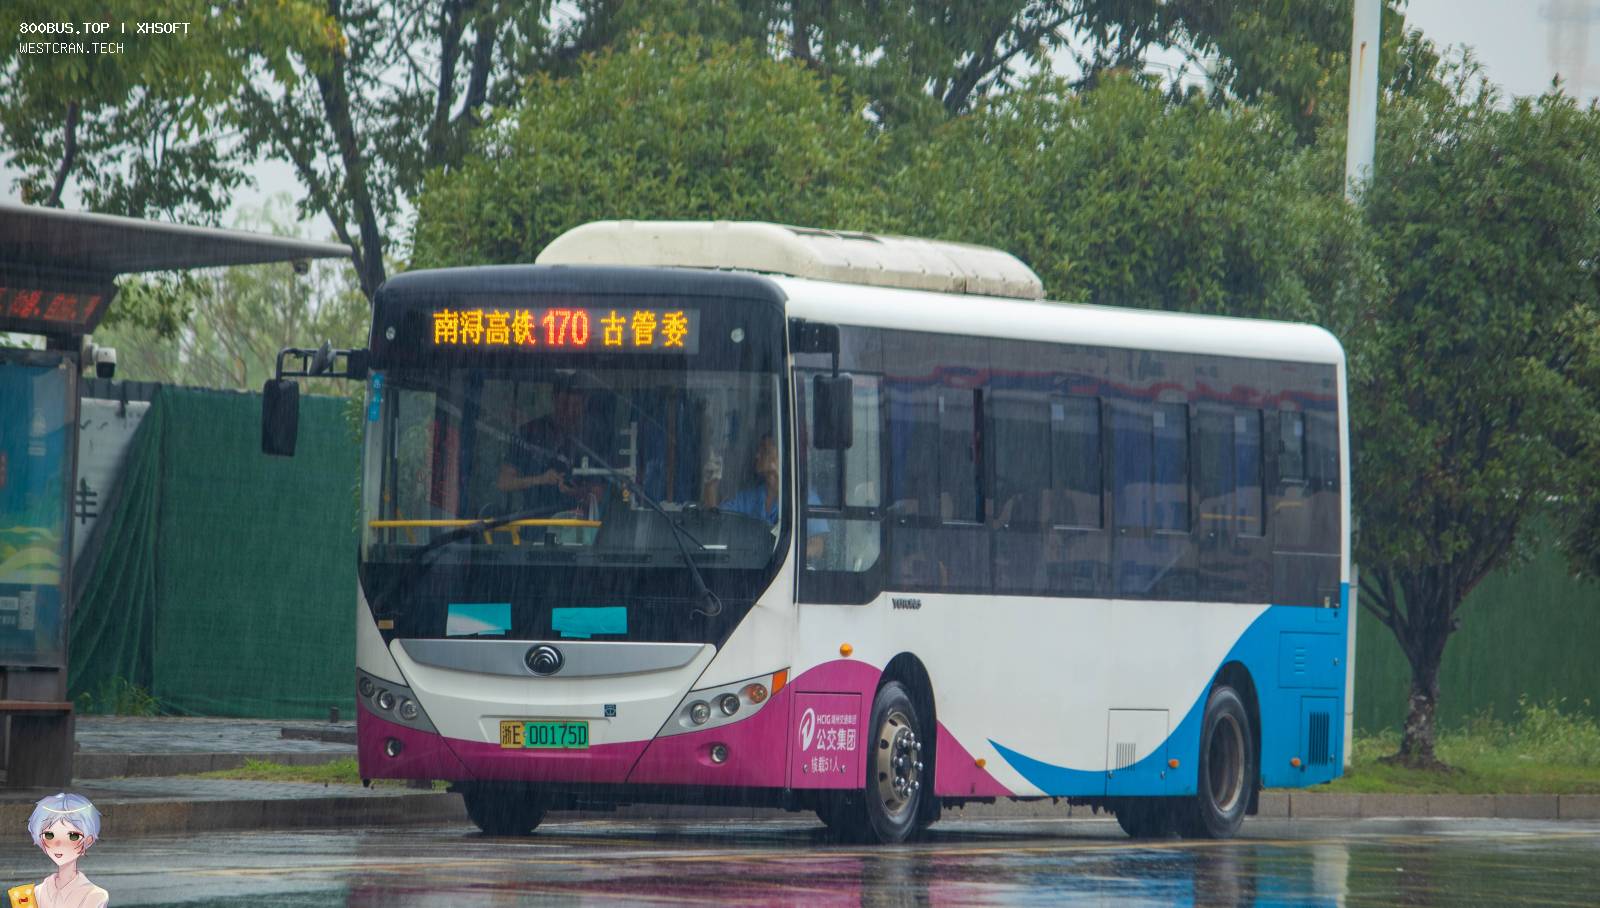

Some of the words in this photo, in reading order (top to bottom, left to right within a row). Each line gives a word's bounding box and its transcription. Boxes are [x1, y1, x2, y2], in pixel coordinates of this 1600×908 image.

[433, 309, 535, 345] 南浔高铁
[542, 309, 590, 346] 170
[600, 311, 687, 346] 古管委
[816, 728, 856, 750] 公交集团
